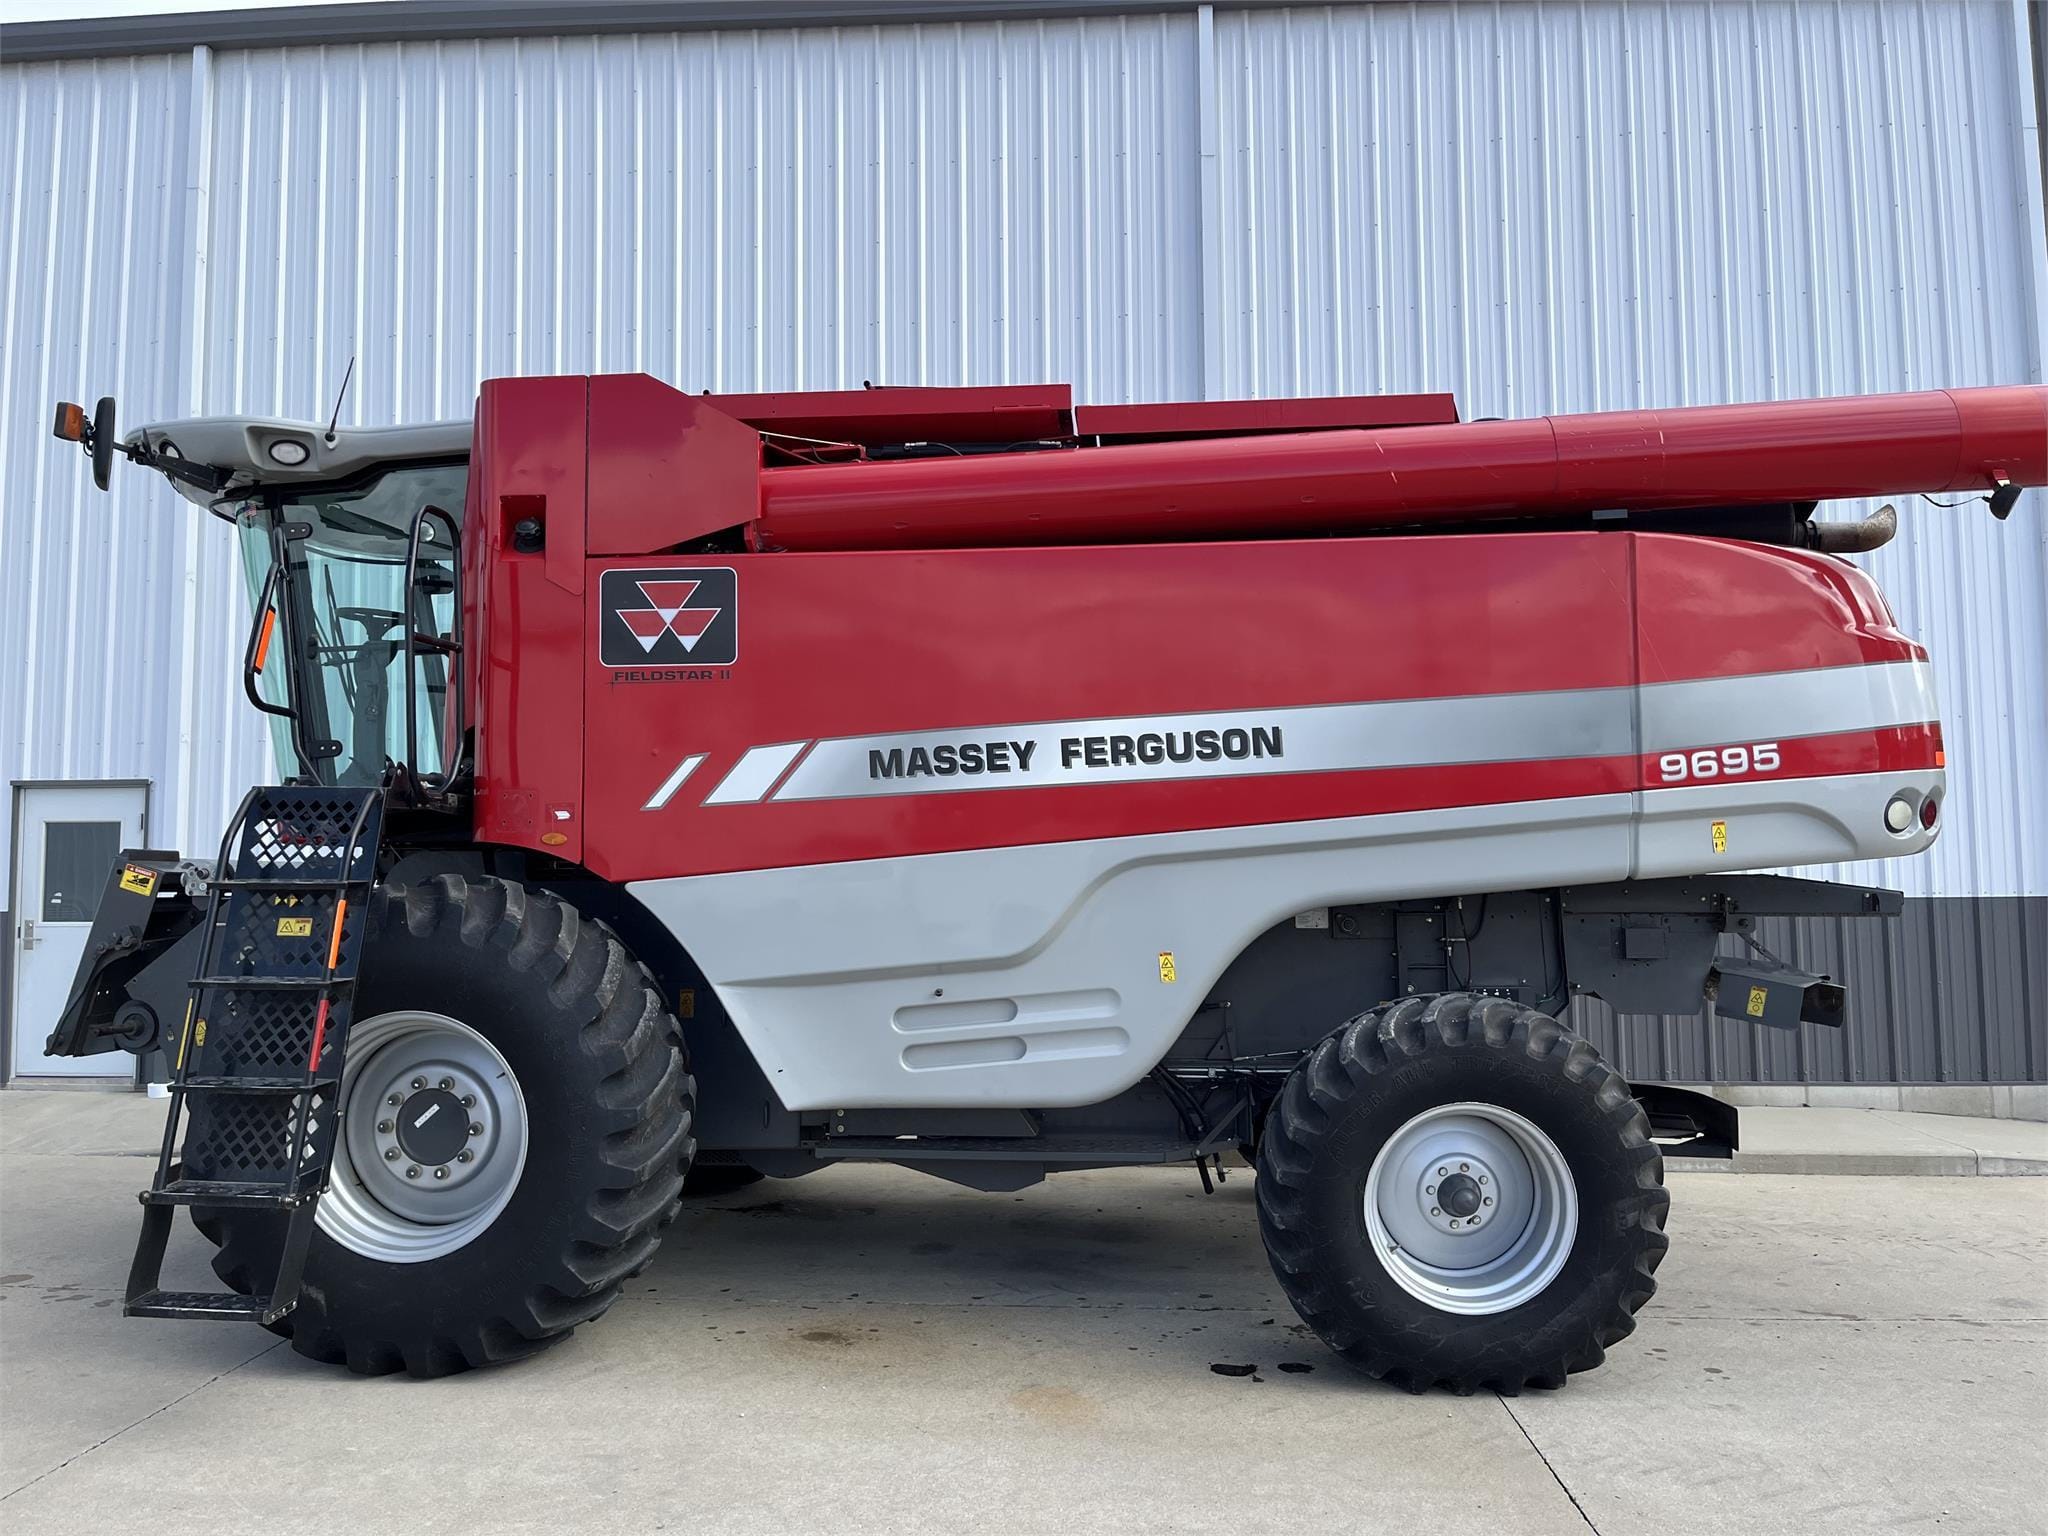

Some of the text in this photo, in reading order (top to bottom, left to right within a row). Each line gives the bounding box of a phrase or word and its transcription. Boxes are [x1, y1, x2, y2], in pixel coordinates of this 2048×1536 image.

[613, 670, 731, 681] FIELDSTAR II
[868, 726, 1284, 780] MASSEY FERGUSON
[1660, 743, 1780, 782] 9695
